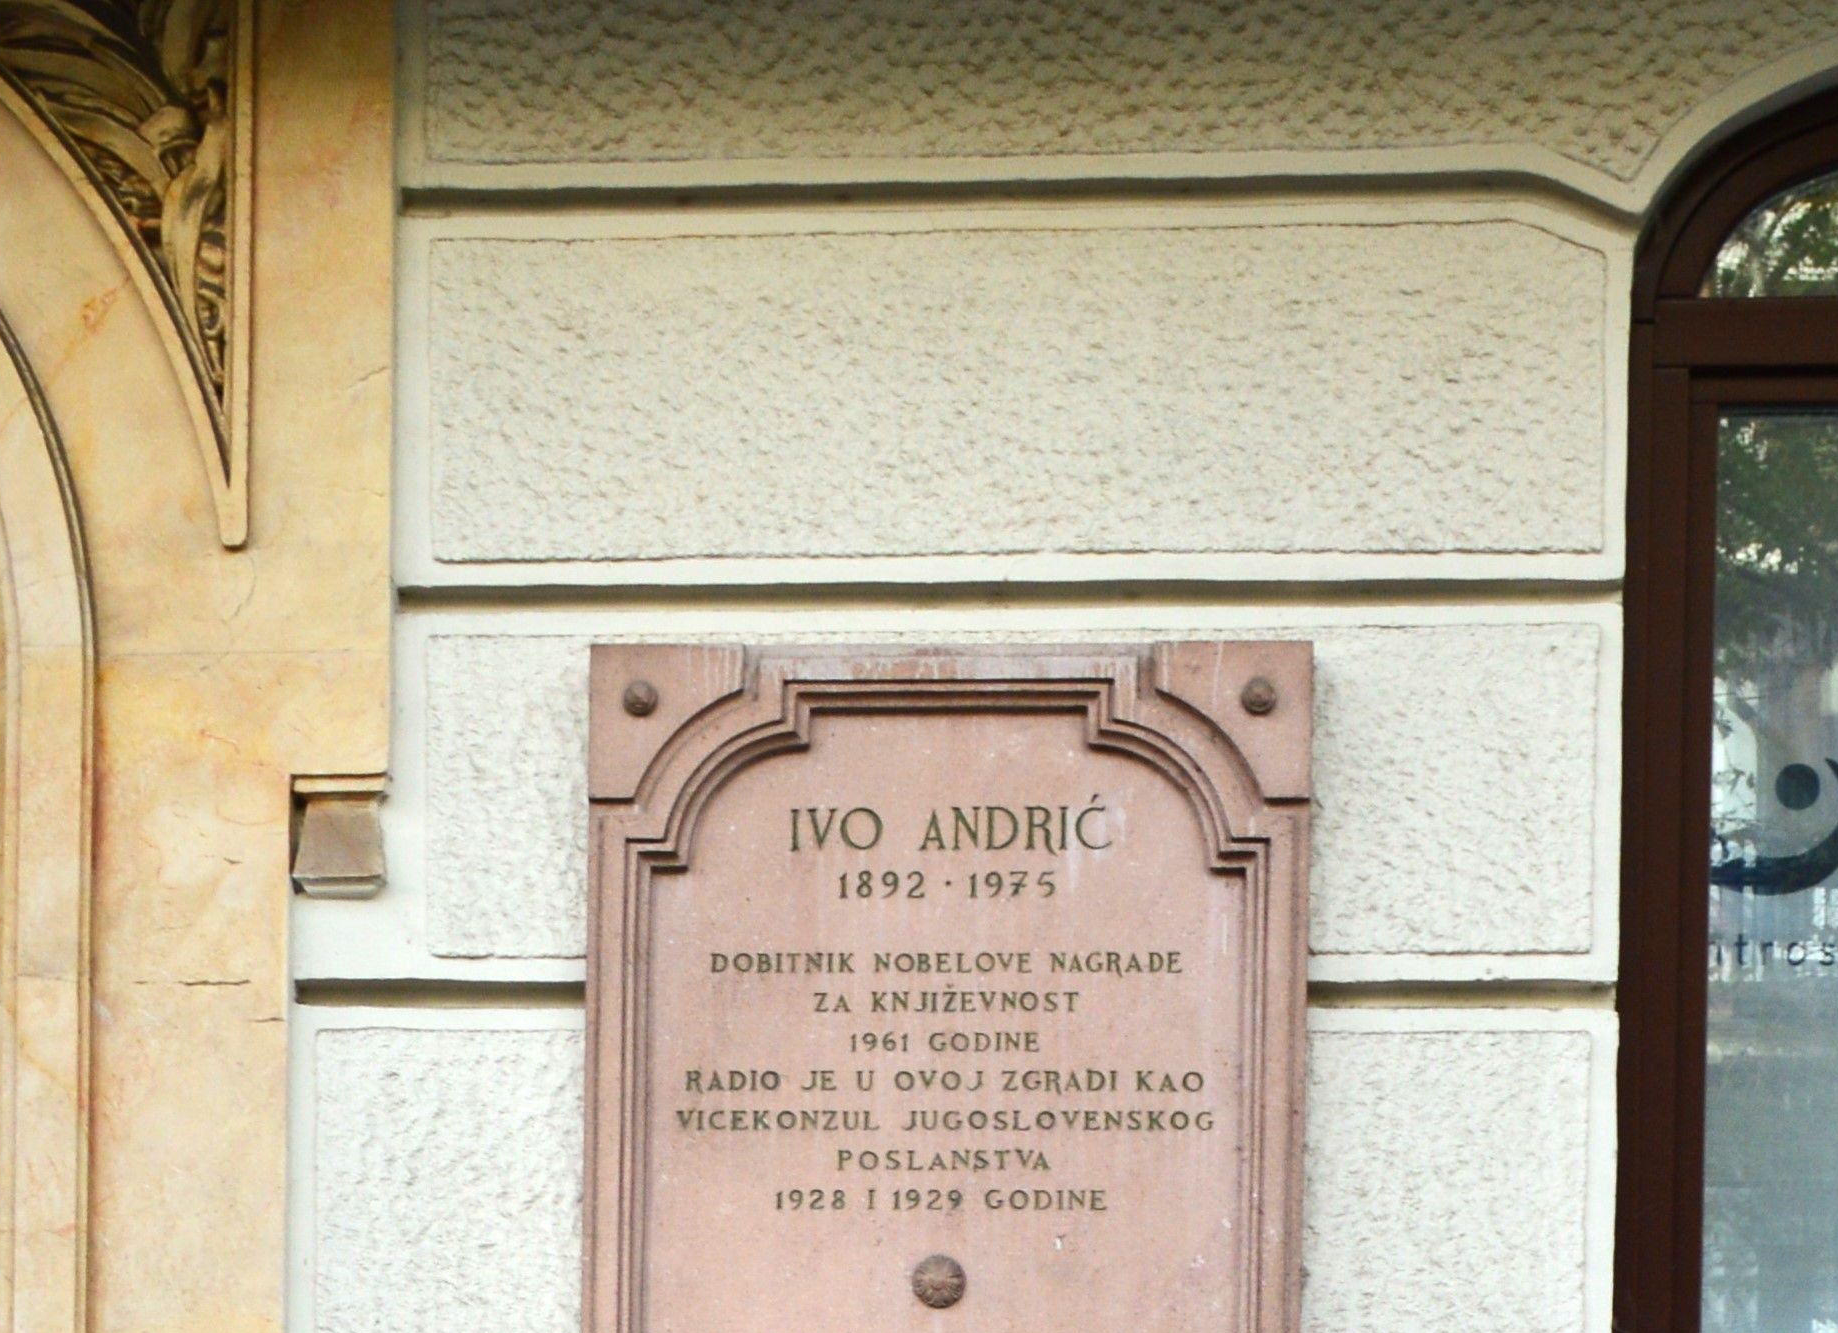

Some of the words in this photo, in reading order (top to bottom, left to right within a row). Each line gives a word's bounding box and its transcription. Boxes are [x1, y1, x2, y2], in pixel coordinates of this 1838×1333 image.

[789, 806, 884, 853] IVO
[918, 793, 1113, 856] ANDRIĆ
[838, 869, 926, 900] 1892
[969, 870, 1057, 899] 1975
[710, 951, 855, 974] DOBITNIK
[873, 951, 1032, 974] NOBELOVE
[1049, 950, 1183, 978] NAGRADE
[813, 992, 852, 1013] ZA
[871, 984, 1080, 1014] KNJIŽEVNOST
[850, 1031, 909, 1053] 1961
[928, 1031, 1040, 1053] GODINE
[685, 1069, 782, 1094] RADIO
[801, 1069, 837, 1092] JE
[855, 1069, 875, 1092] U
[893, 1069, 984, 1092] OVOJ
[1001, 1067, 1118, 1095] ZGRADI
[1136, 1070, 1205, 1093] KAO
[675, 1108, 880, 1132] VICEKONZUL
[901, 1109, 1215, 1133] JUGOSLOVENSKOG
[837, 1148, 1051, 1173] POSLANSTVA
[775, 1188, 846, 1211] 1928
[865, 1188, 877, 1211] I
[892, 1188, 964, 1211] 1929
[984, 1189, 1108, 1212] GODINE
